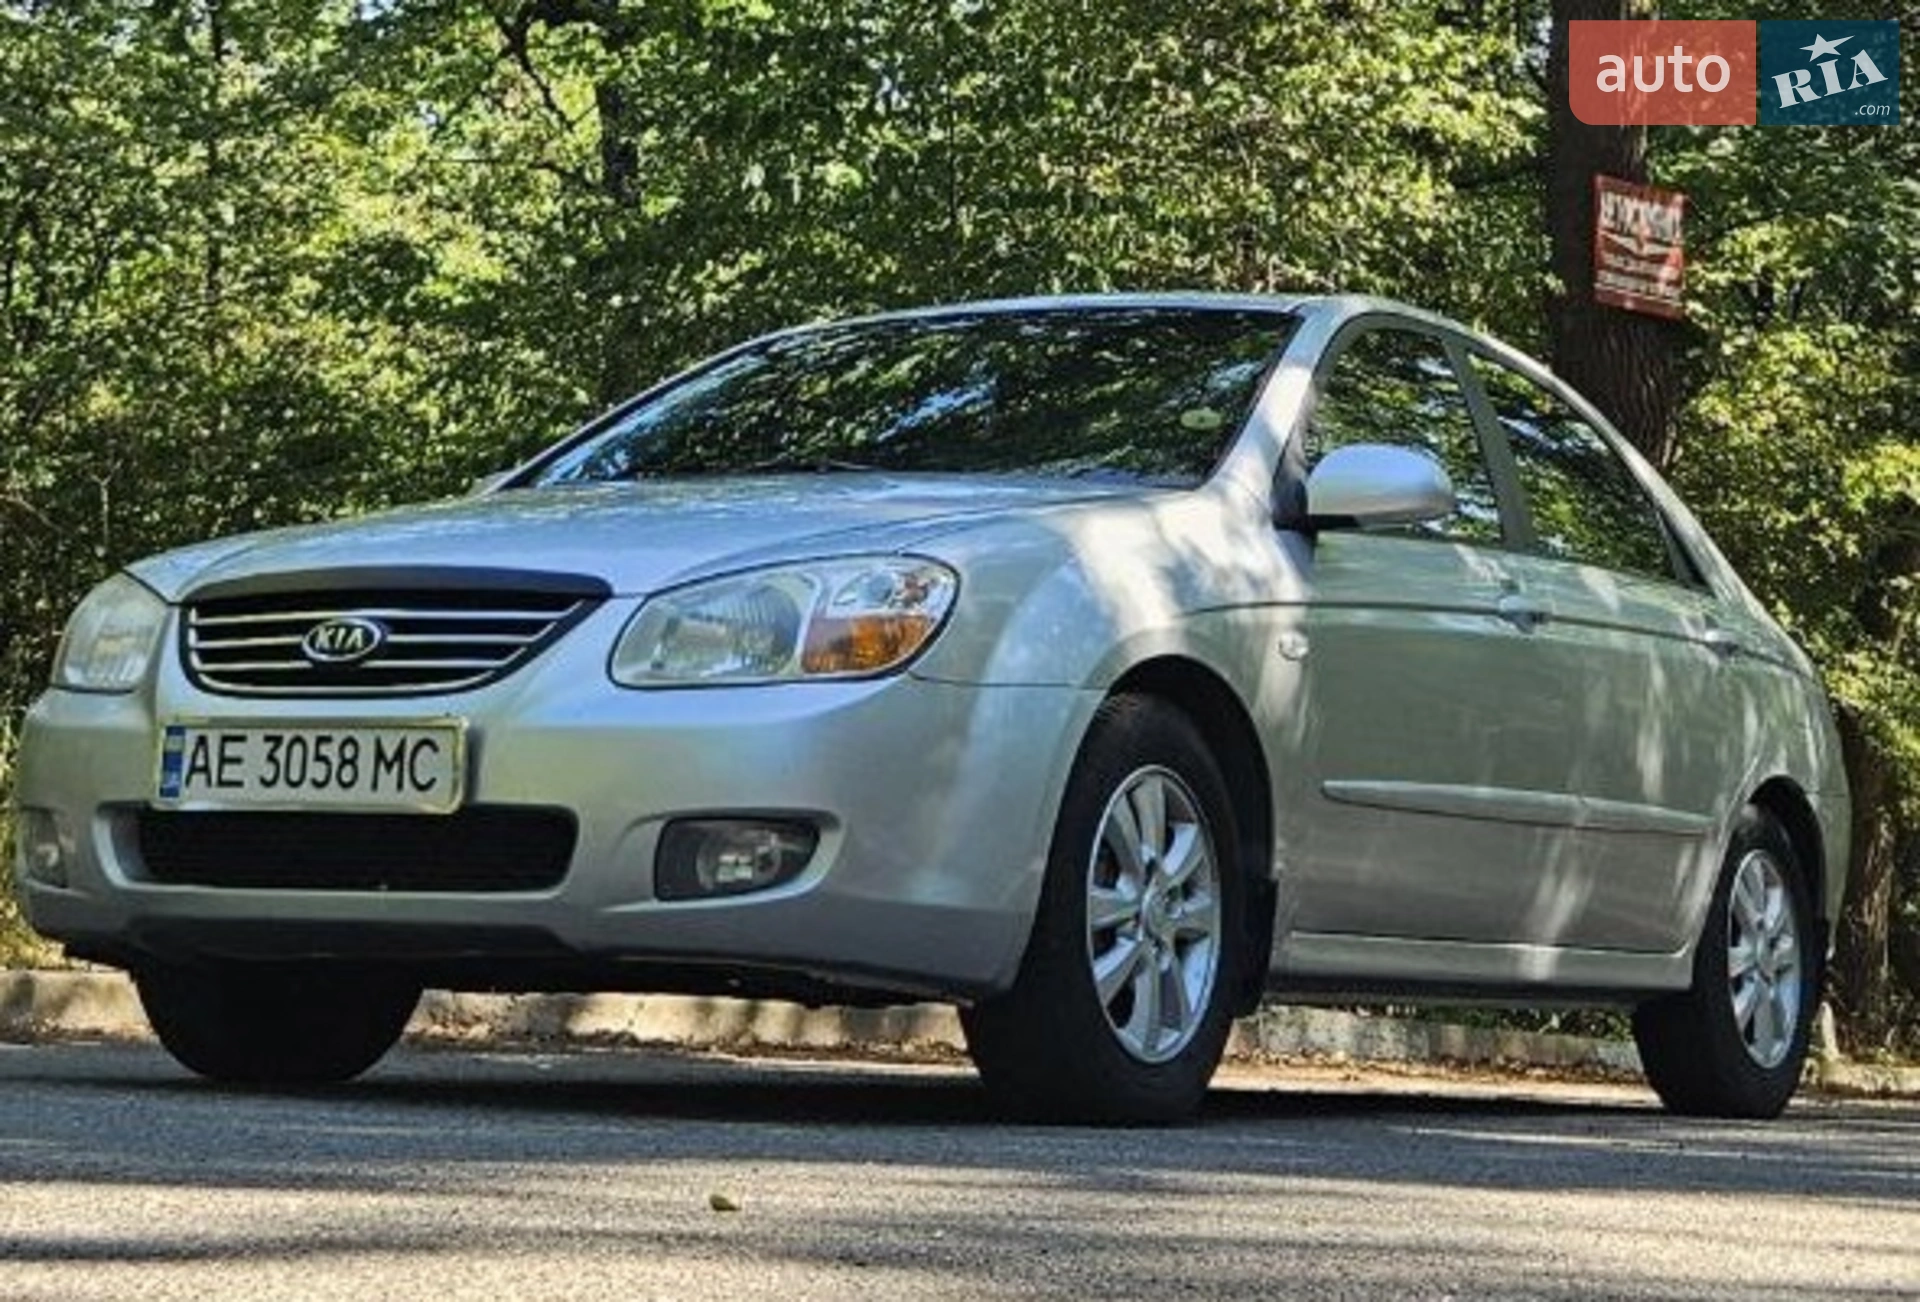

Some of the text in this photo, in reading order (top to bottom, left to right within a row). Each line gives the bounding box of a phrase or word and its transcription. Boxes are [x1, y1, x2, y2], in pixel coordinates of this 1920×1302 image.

[315, 625, 364, 650] KIA
[185, 734, 440, 792] AE 3058 MC
